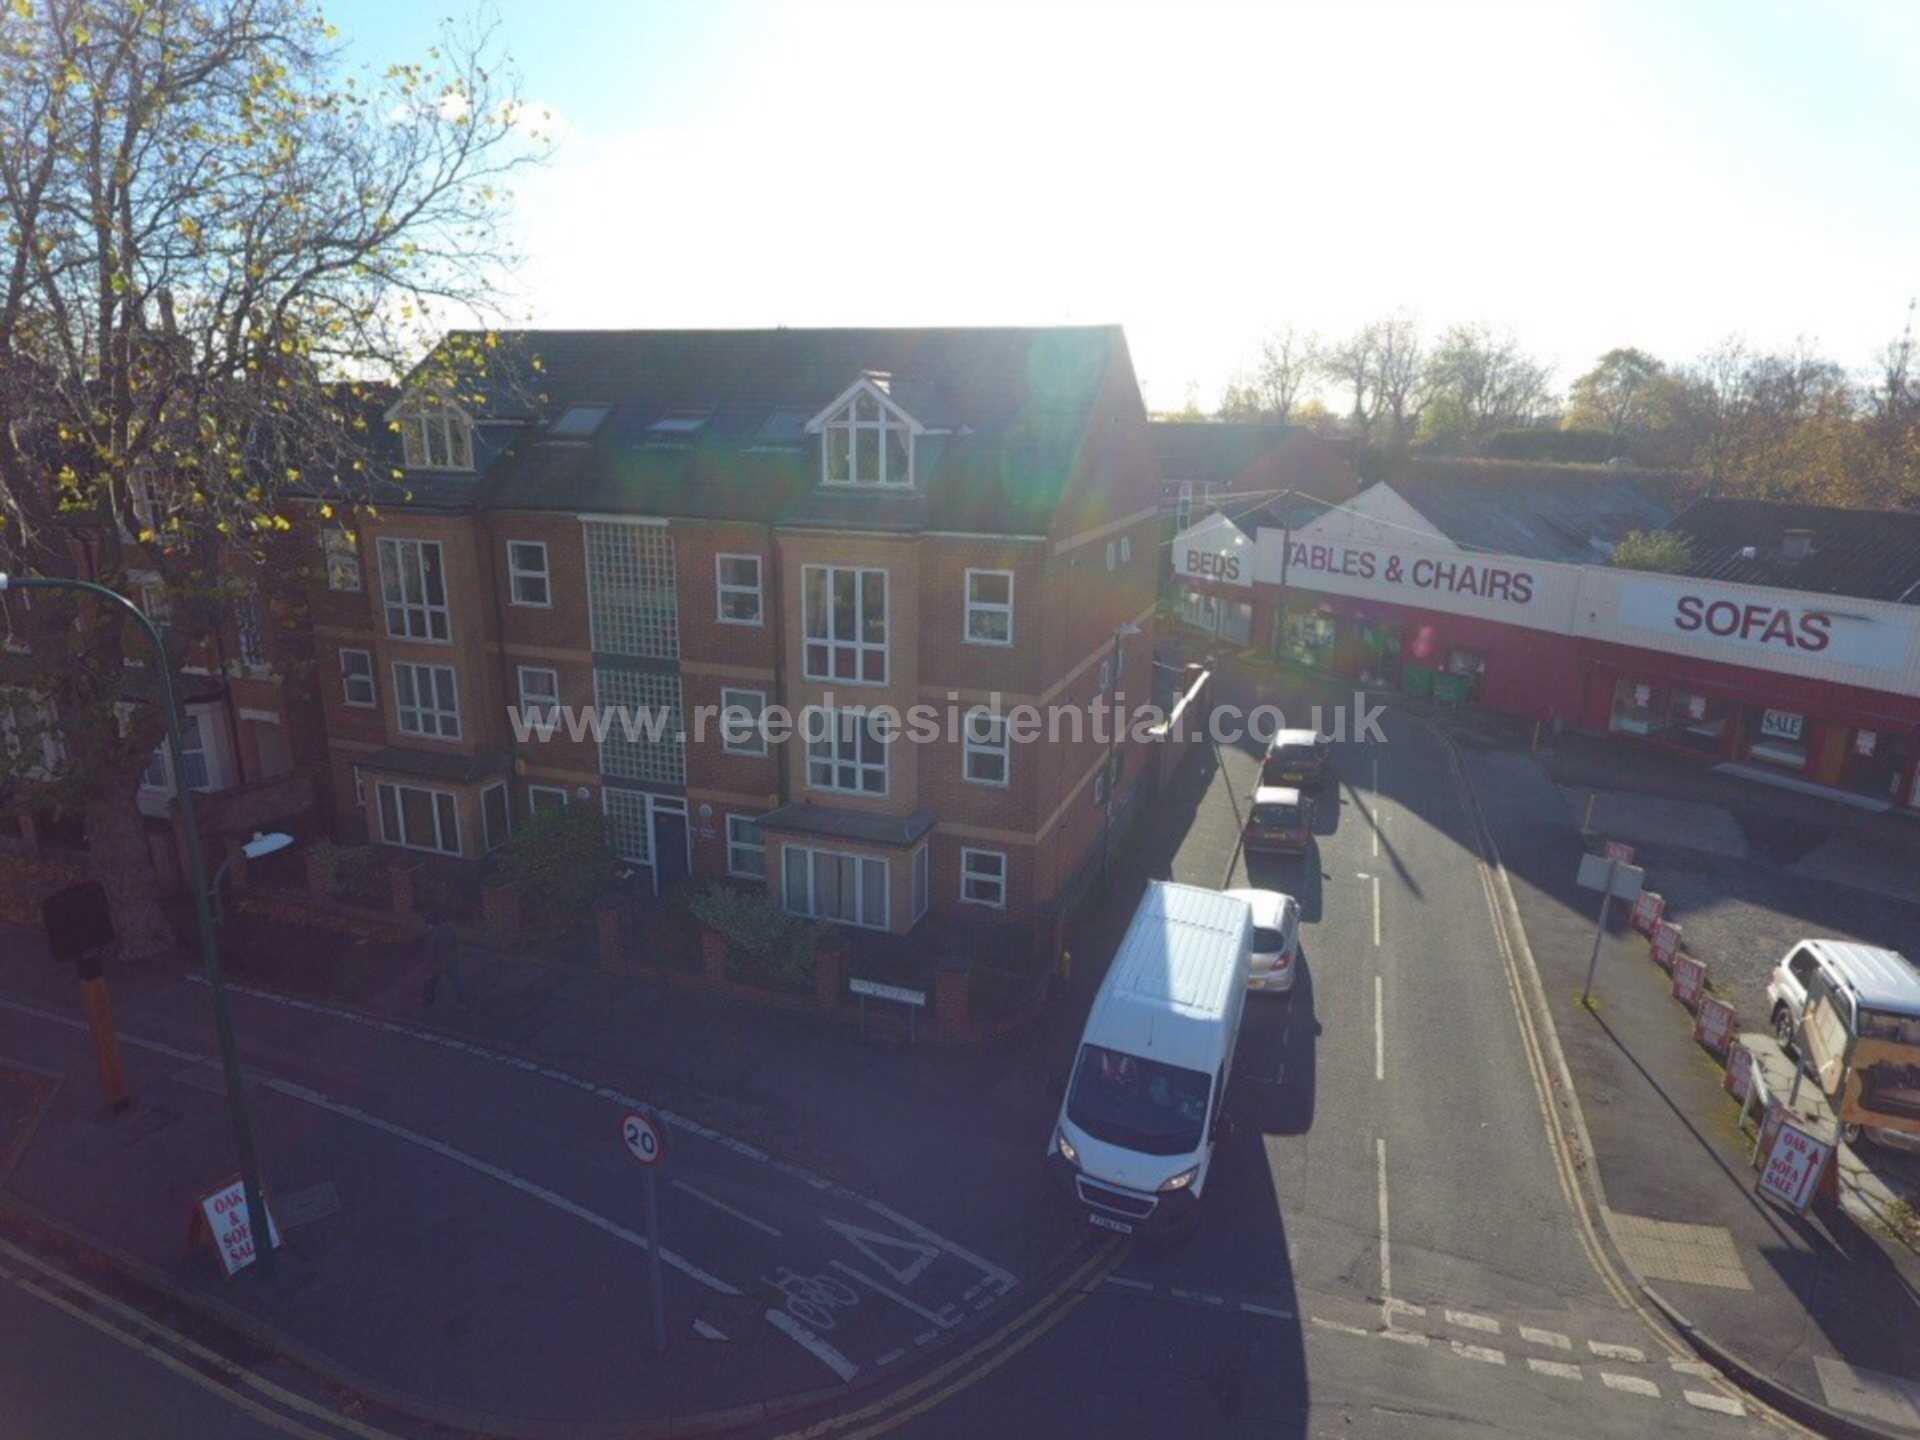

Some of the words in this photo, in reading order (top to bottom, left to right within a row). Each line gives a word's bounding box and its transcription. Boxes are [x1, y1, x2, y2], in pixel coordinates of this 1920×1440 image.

[1187, 550, 1240, 580] BEDS
[1285, 541, 1376, 579] TABLES
[1385, 555, 1403, 584] &
[1412, 559, 1533, 604] CHAIRS
[1675, 596, 1831, 651] SOFAS
[1766, 711, 1801, 736] SALE
[627, 1123, 654, 1154] 20
[1784, 1131, 1808, 1154] OAK
[1785, 1150, 1795, 1163] &
[1766, 1172, 1794, 1194] SALE
[1772, 1158, 1799, 1183] SOFA
[215, 1188, 243, 1214] OAK
[229, 1211, 240, 1226] &
[224, 1226, 250, 1249] SOF
[231, 1241, 255, 1261] SAL
